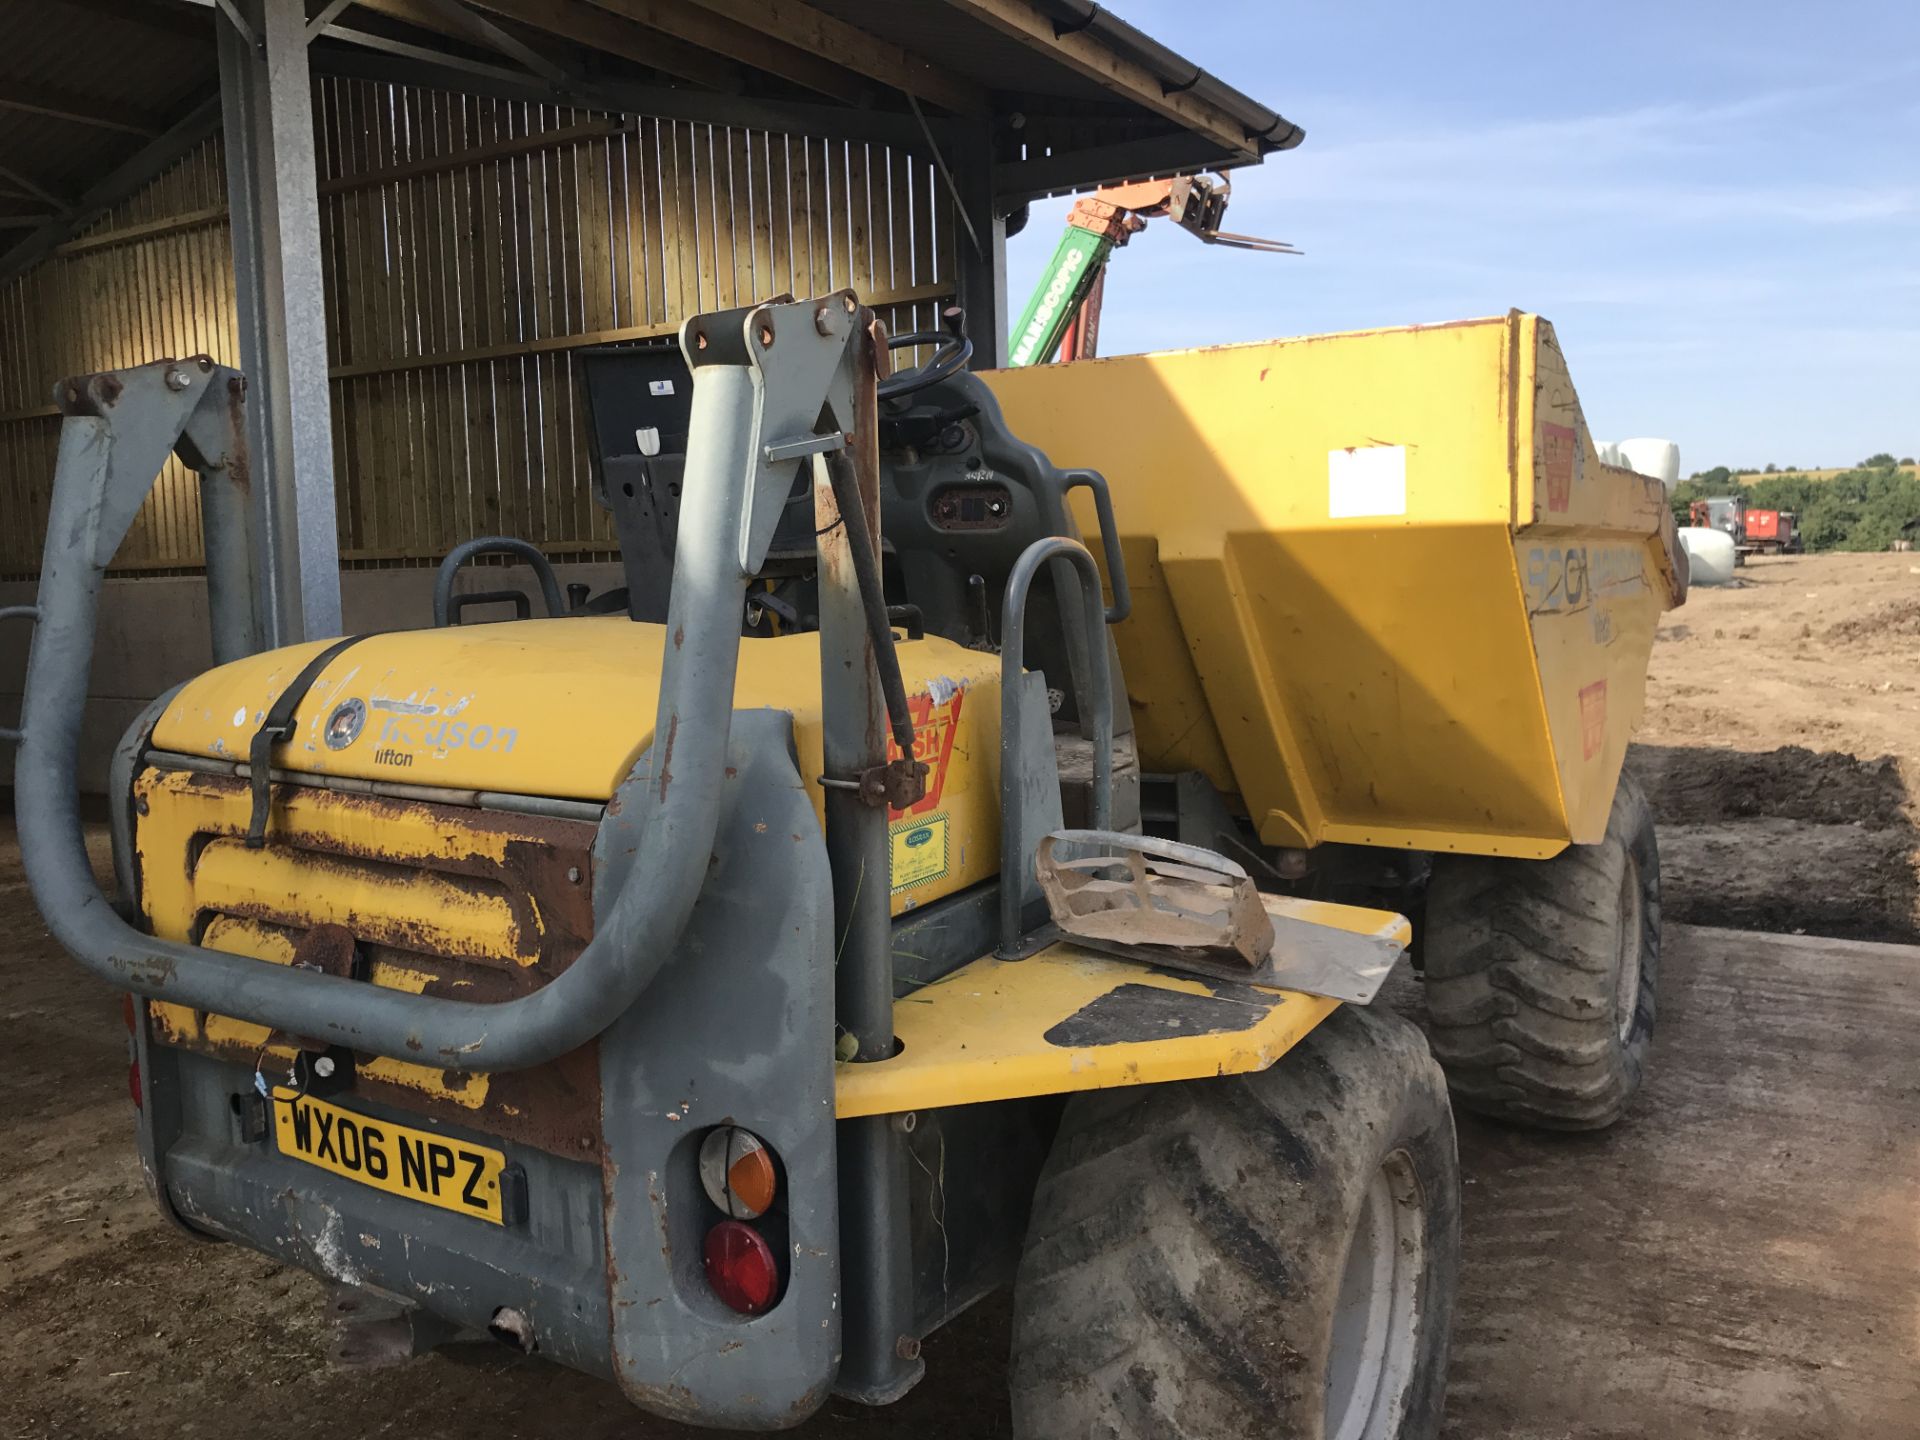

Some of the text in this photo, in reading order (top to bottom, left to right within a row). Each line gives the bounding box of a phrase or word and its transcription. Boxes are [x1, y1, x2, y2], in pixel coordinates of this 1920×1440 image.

[374, 748, 414, 767] lifton
[291, 1100, 488, 1210] WX06 NPZ
